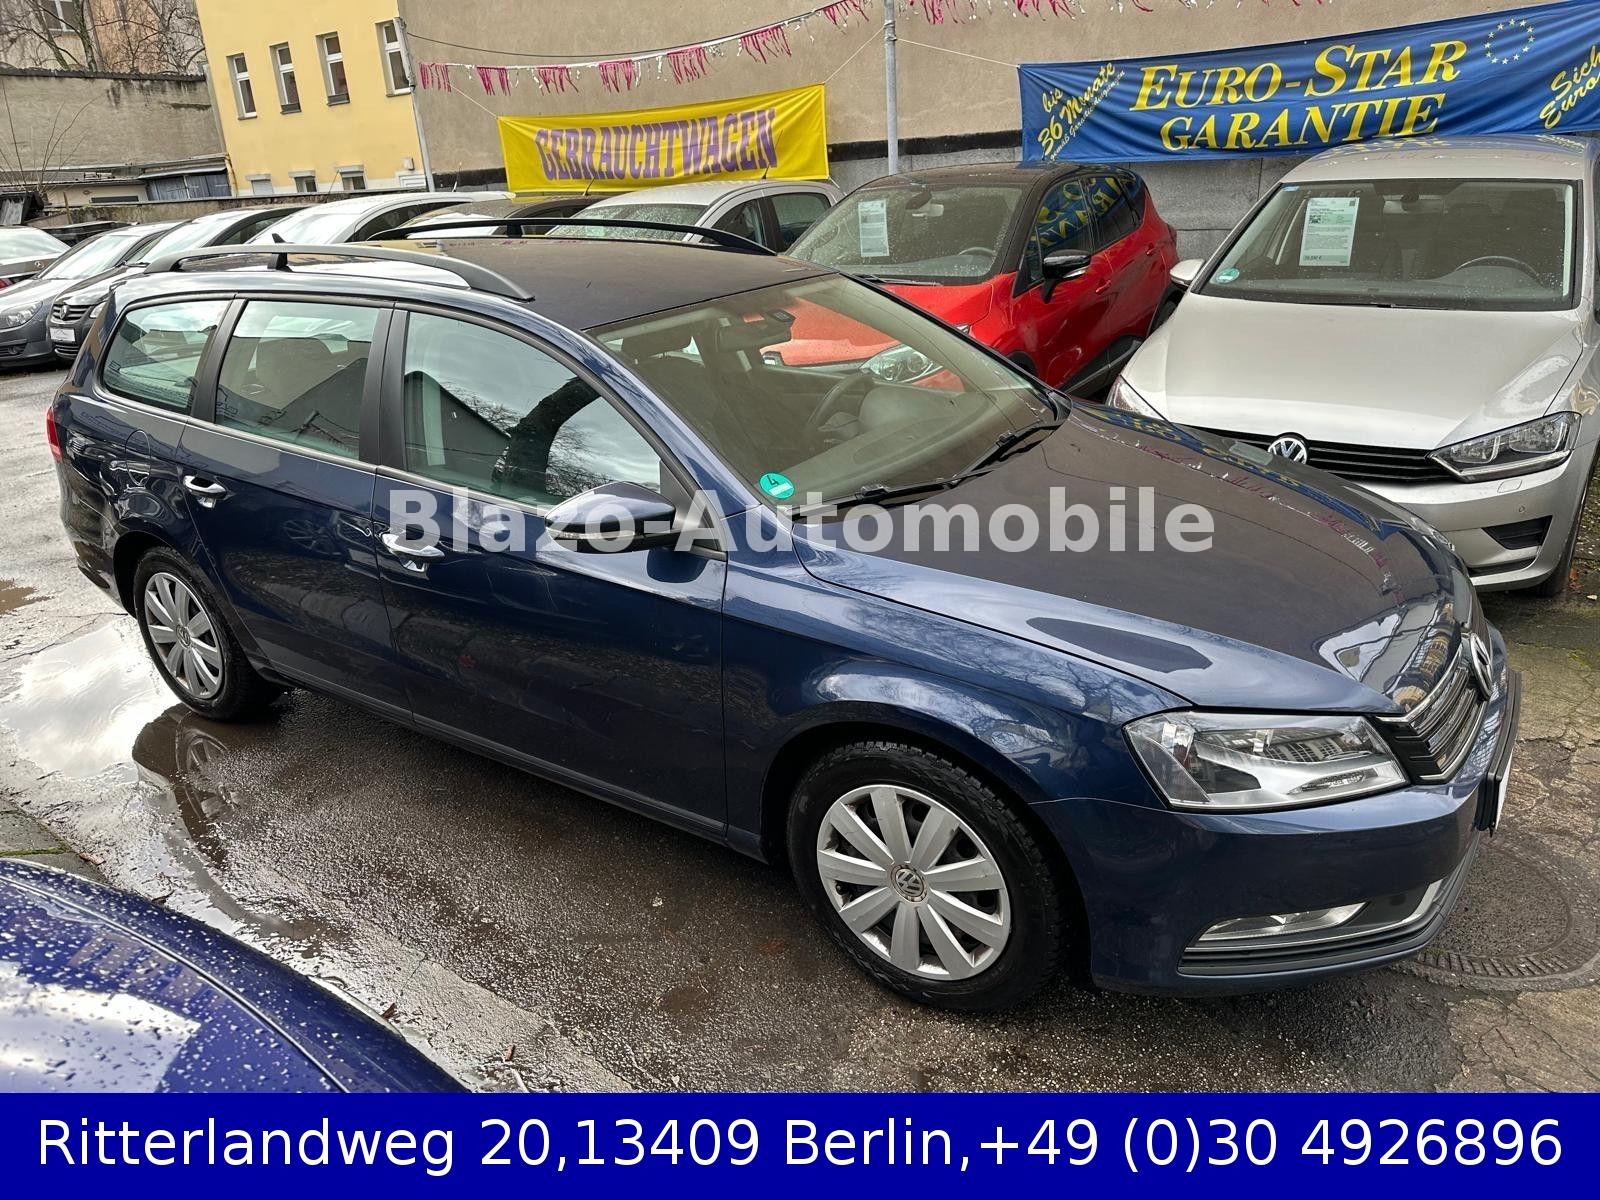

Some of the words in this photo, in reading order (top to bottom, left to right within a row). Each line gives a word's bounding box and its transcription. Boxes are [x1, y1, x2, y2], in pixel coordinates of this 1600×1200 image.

[1042, 88, 1063, 113] bis
[1129, 40, 1467, 111] EURO-STAR
[534, 107, 778, 181] GEBRAUCHTWAGEN
[1037, 114, 1063, 156] 36
[1160, 93, 1446, 151] GARANTIE
[766, 474, 780, 486] 4
